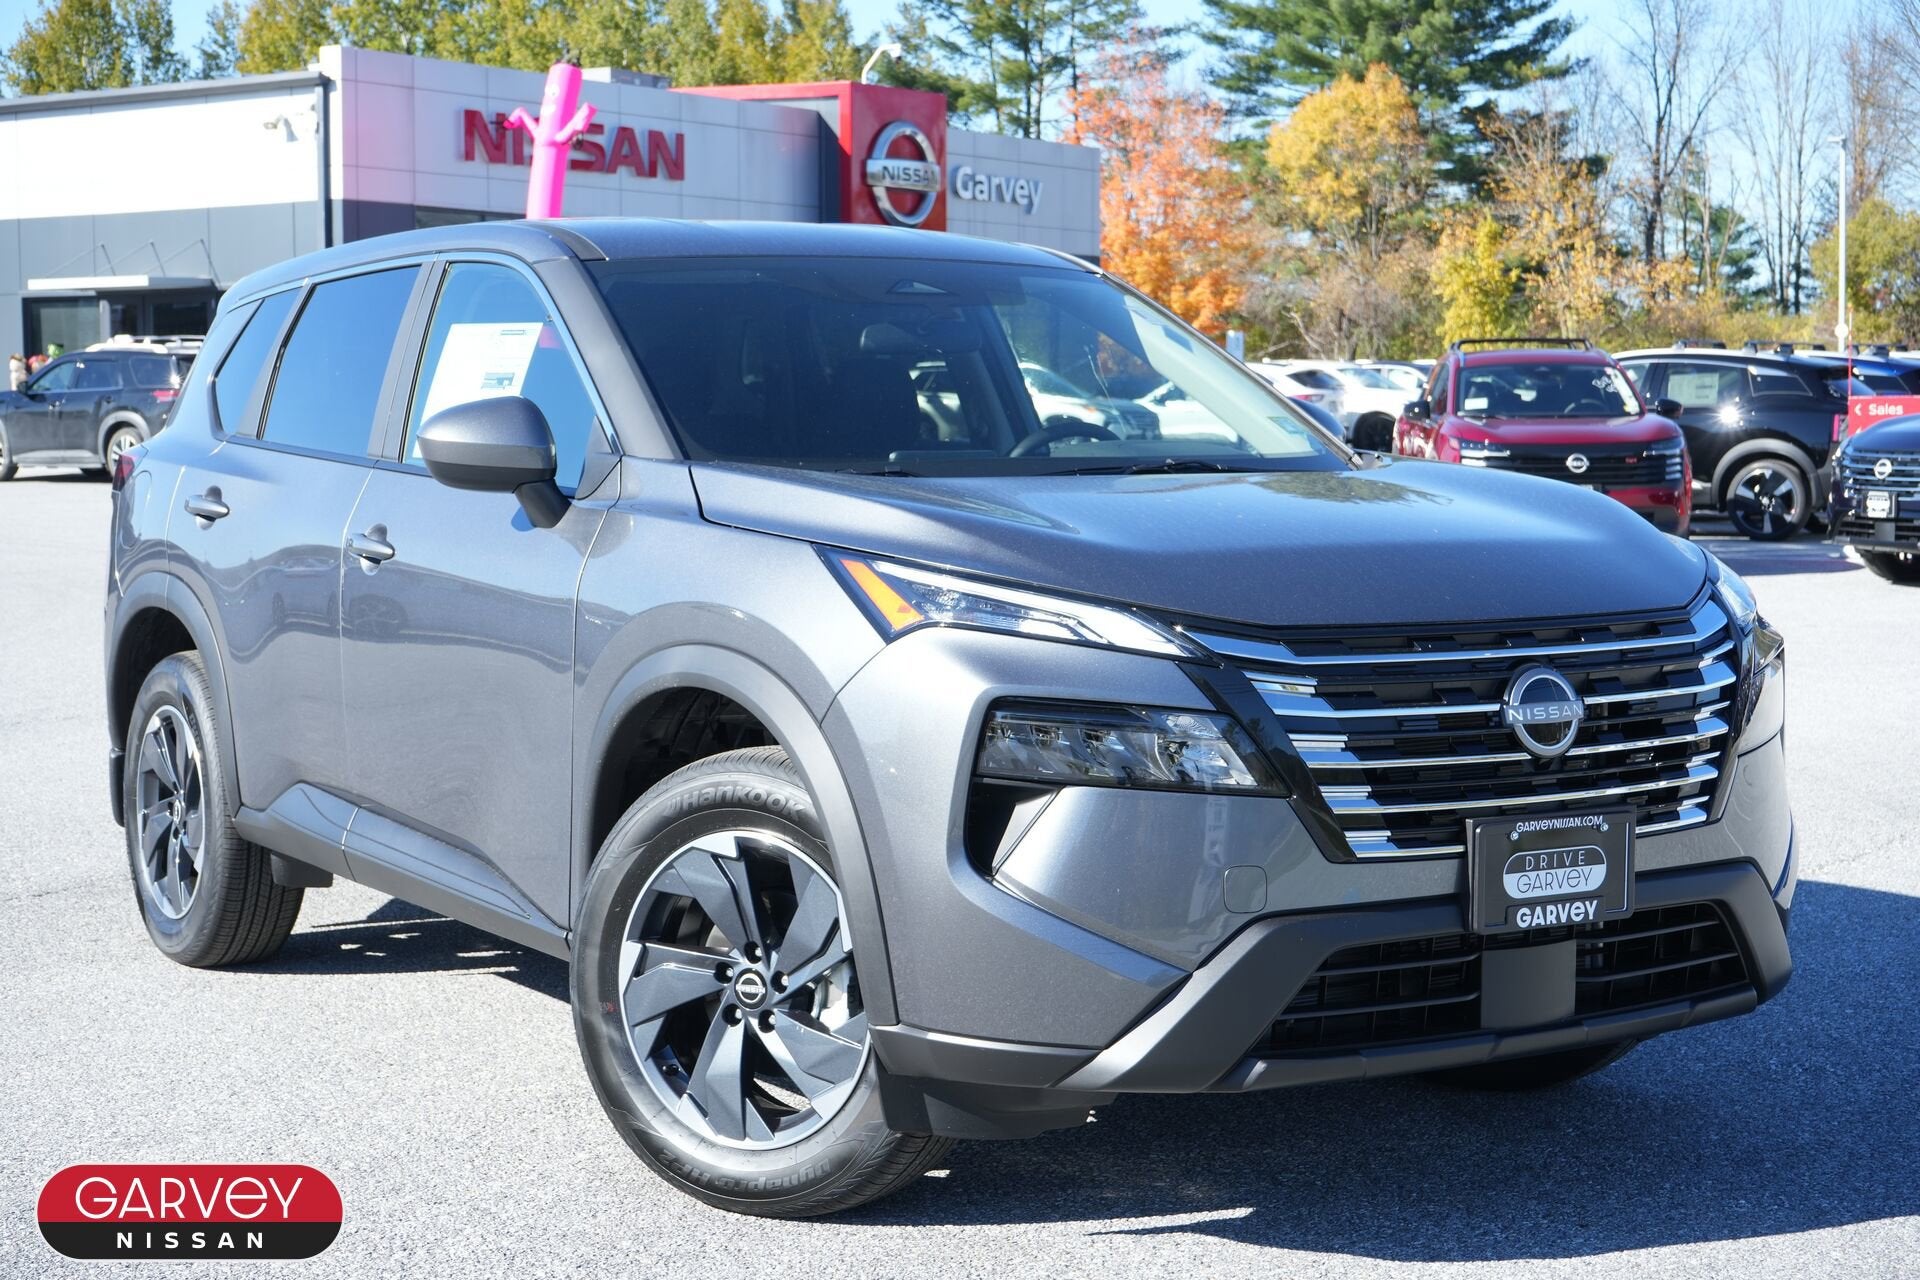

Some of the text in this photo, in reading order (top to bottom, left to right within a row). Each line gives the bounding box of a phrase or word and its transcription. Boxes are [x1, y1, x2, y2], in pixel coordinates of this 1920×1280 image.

[463, 108, 685, 181] NISAN
[956, 166, 1043, 214] Garvey
[1868, 403, 1904, 416] Sales
[1508, 704, 1582, 721] NISSAN
[1525, 851, 1586, 870] DRIVE
